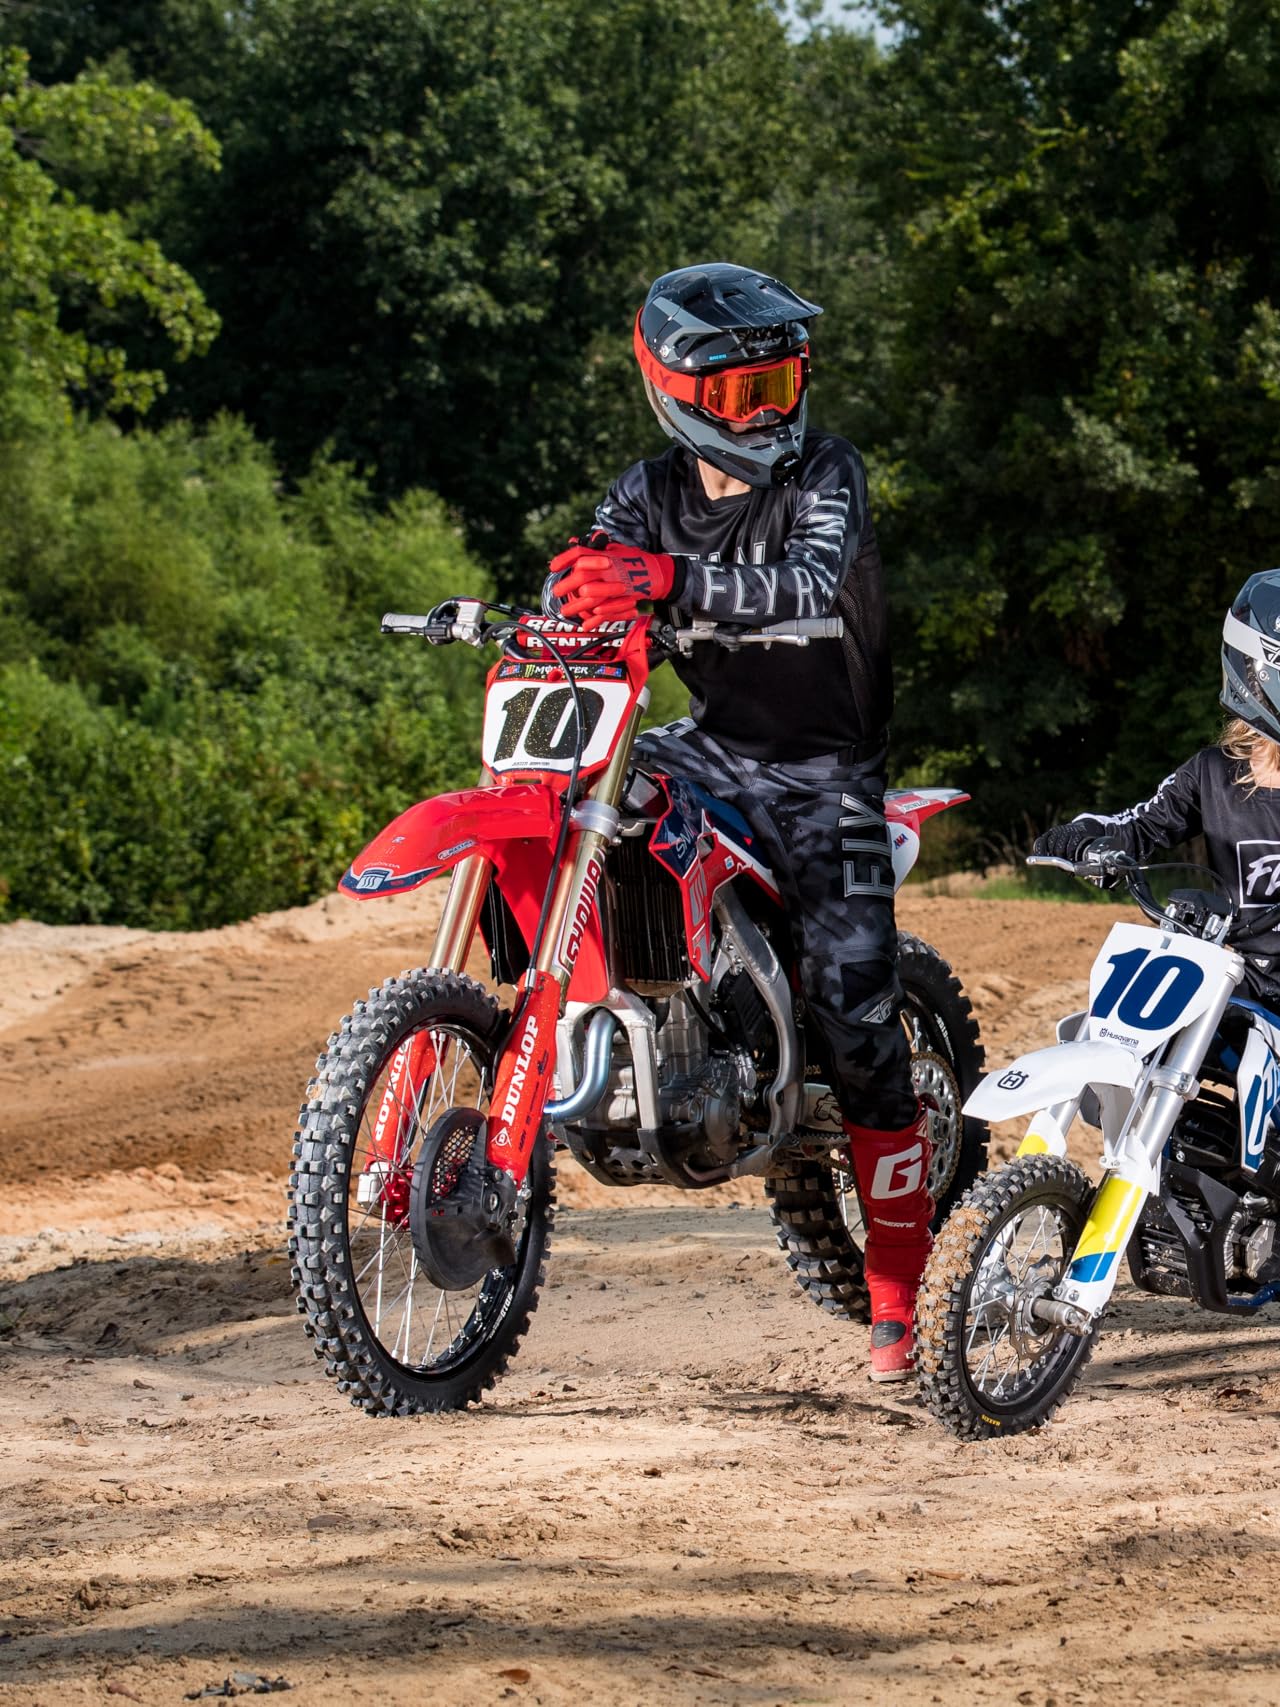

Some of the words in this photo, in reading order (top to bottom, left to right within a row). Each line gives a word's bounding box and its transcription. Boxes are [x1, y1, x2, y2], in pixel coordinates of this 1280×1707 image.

[622, 557, 652, 596] FLY
[701, 565, 779, 616] FLY
[493, 687, 605, 762] 10
[838, 792, 894, 899] FLY
[1090, 947, 1204, 1030] 10
[501, 1015, 539, 1127] DUNLOP
[870, 1142, 923, 1200] G
